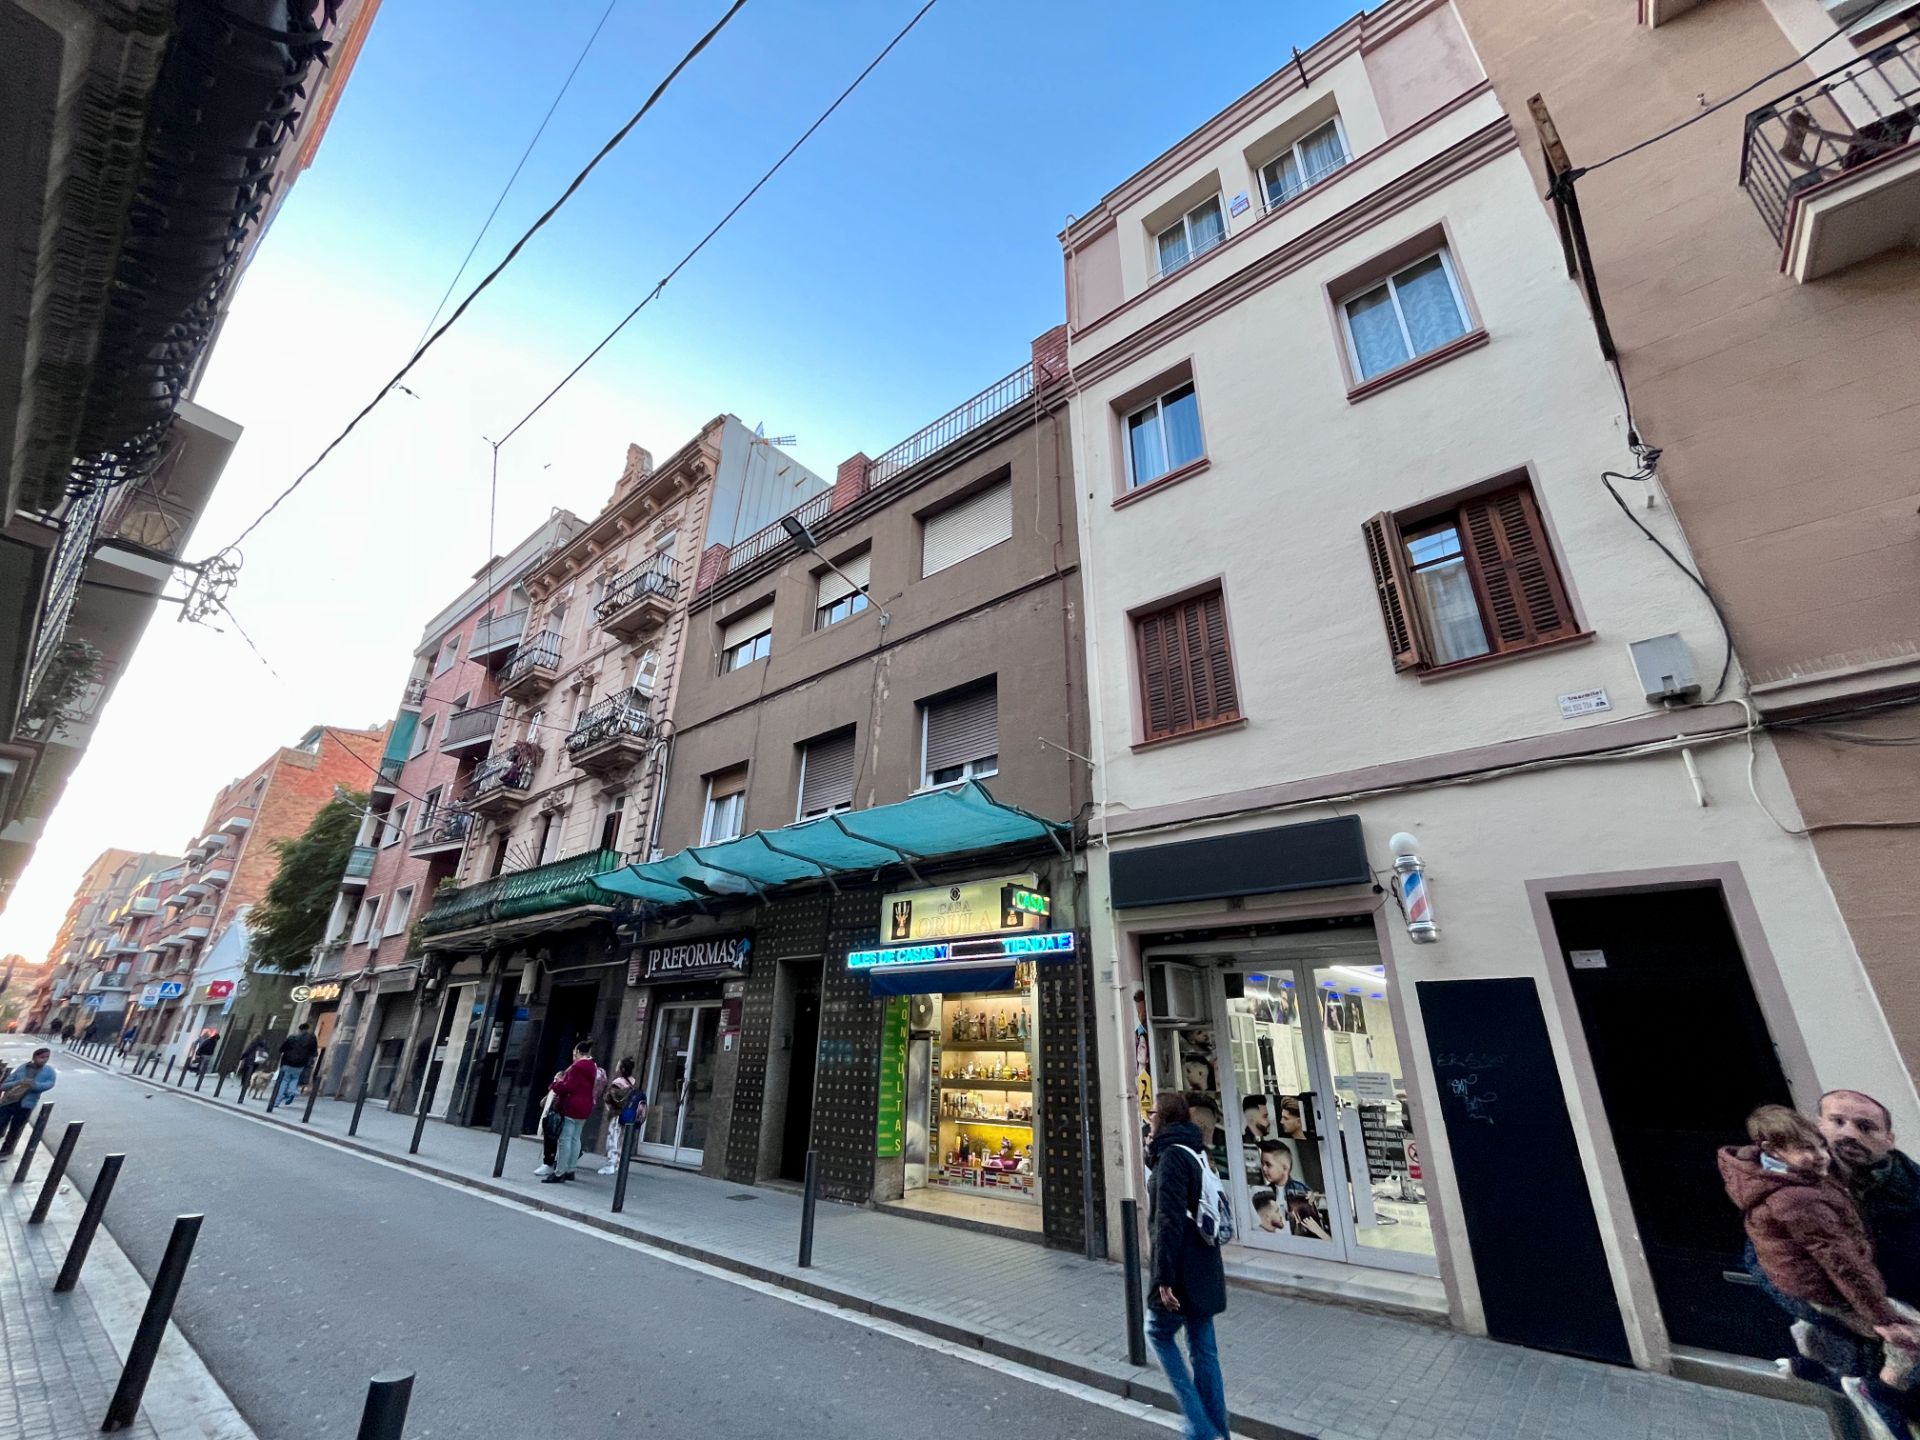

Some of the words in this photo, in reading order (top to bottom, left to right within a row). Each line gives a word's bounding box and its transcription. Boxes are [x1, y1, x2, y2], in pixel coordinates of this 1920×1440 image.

[938, 901, 970, 913] CASA
[1016, 891, 1045, 912] CASA
[916, 910, 992, 939] ORULA
[1002, 936, 1056, 953] TIENDA
[645, 949, 660, 978] JP
[661, 939, 737, 970] REFORMAS
